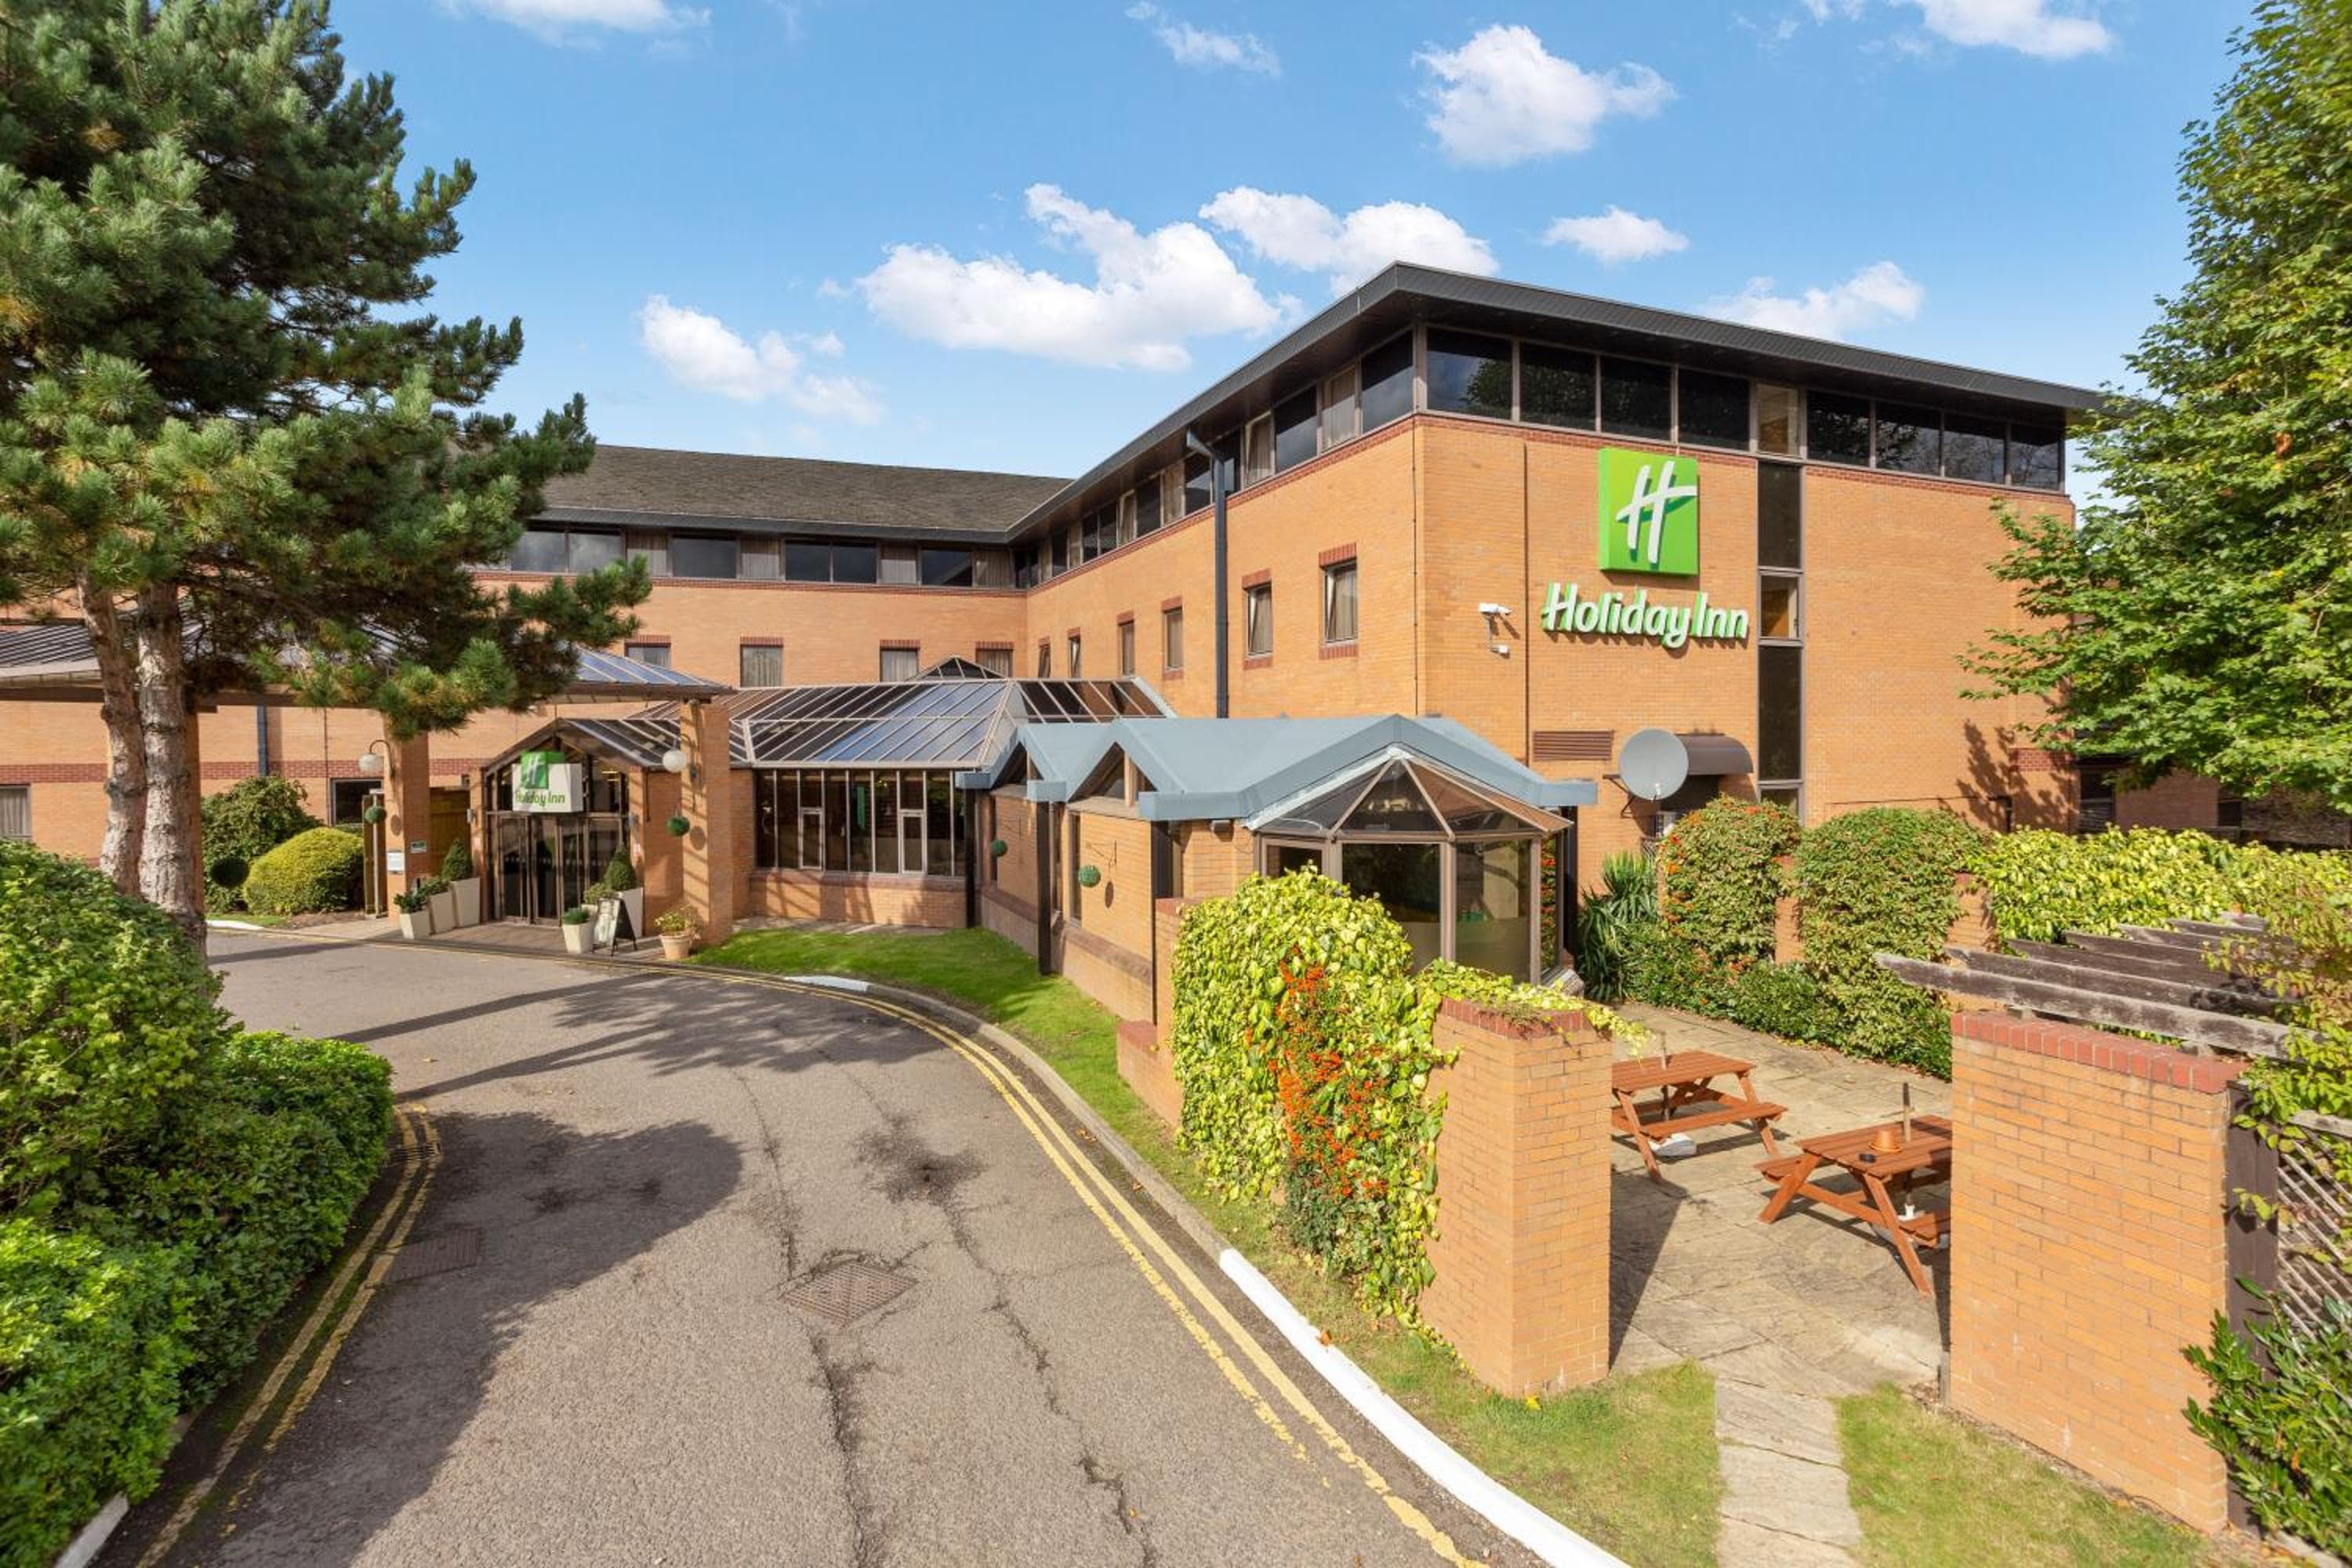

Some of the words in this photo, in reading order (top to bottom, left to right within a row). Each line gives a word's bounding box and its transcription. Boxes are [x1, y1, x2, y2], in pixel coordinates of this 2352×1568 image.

[1542, 582, 1690, 648] Holiday
[1691, 590, 1748, 639] Inn
[515, 789, 546, 807] Holiday
[547, 790, 565, 804] Inn
